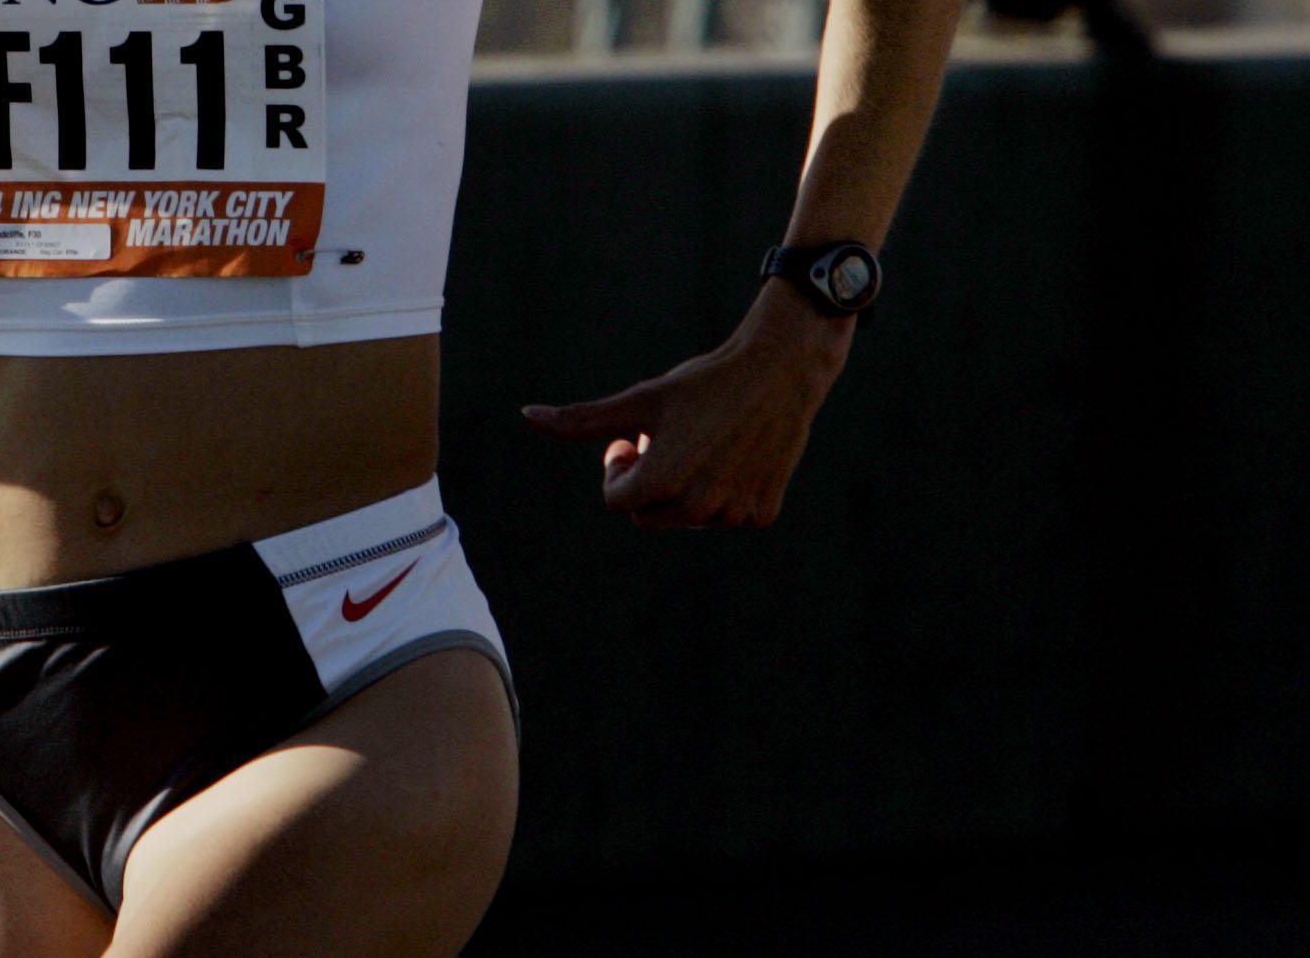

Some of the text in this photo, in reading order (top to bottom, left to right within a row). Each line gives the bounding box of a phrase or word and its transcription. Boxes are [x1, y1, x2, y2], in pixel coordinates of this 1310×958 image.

[10, 190, 62, 219] ING
[67, 190, 136, 219] NEW
[142, 190, 220, 218] YORK
[225, 190, 295, 218] CITY
[125, 218, 290, 247] MARATHON
